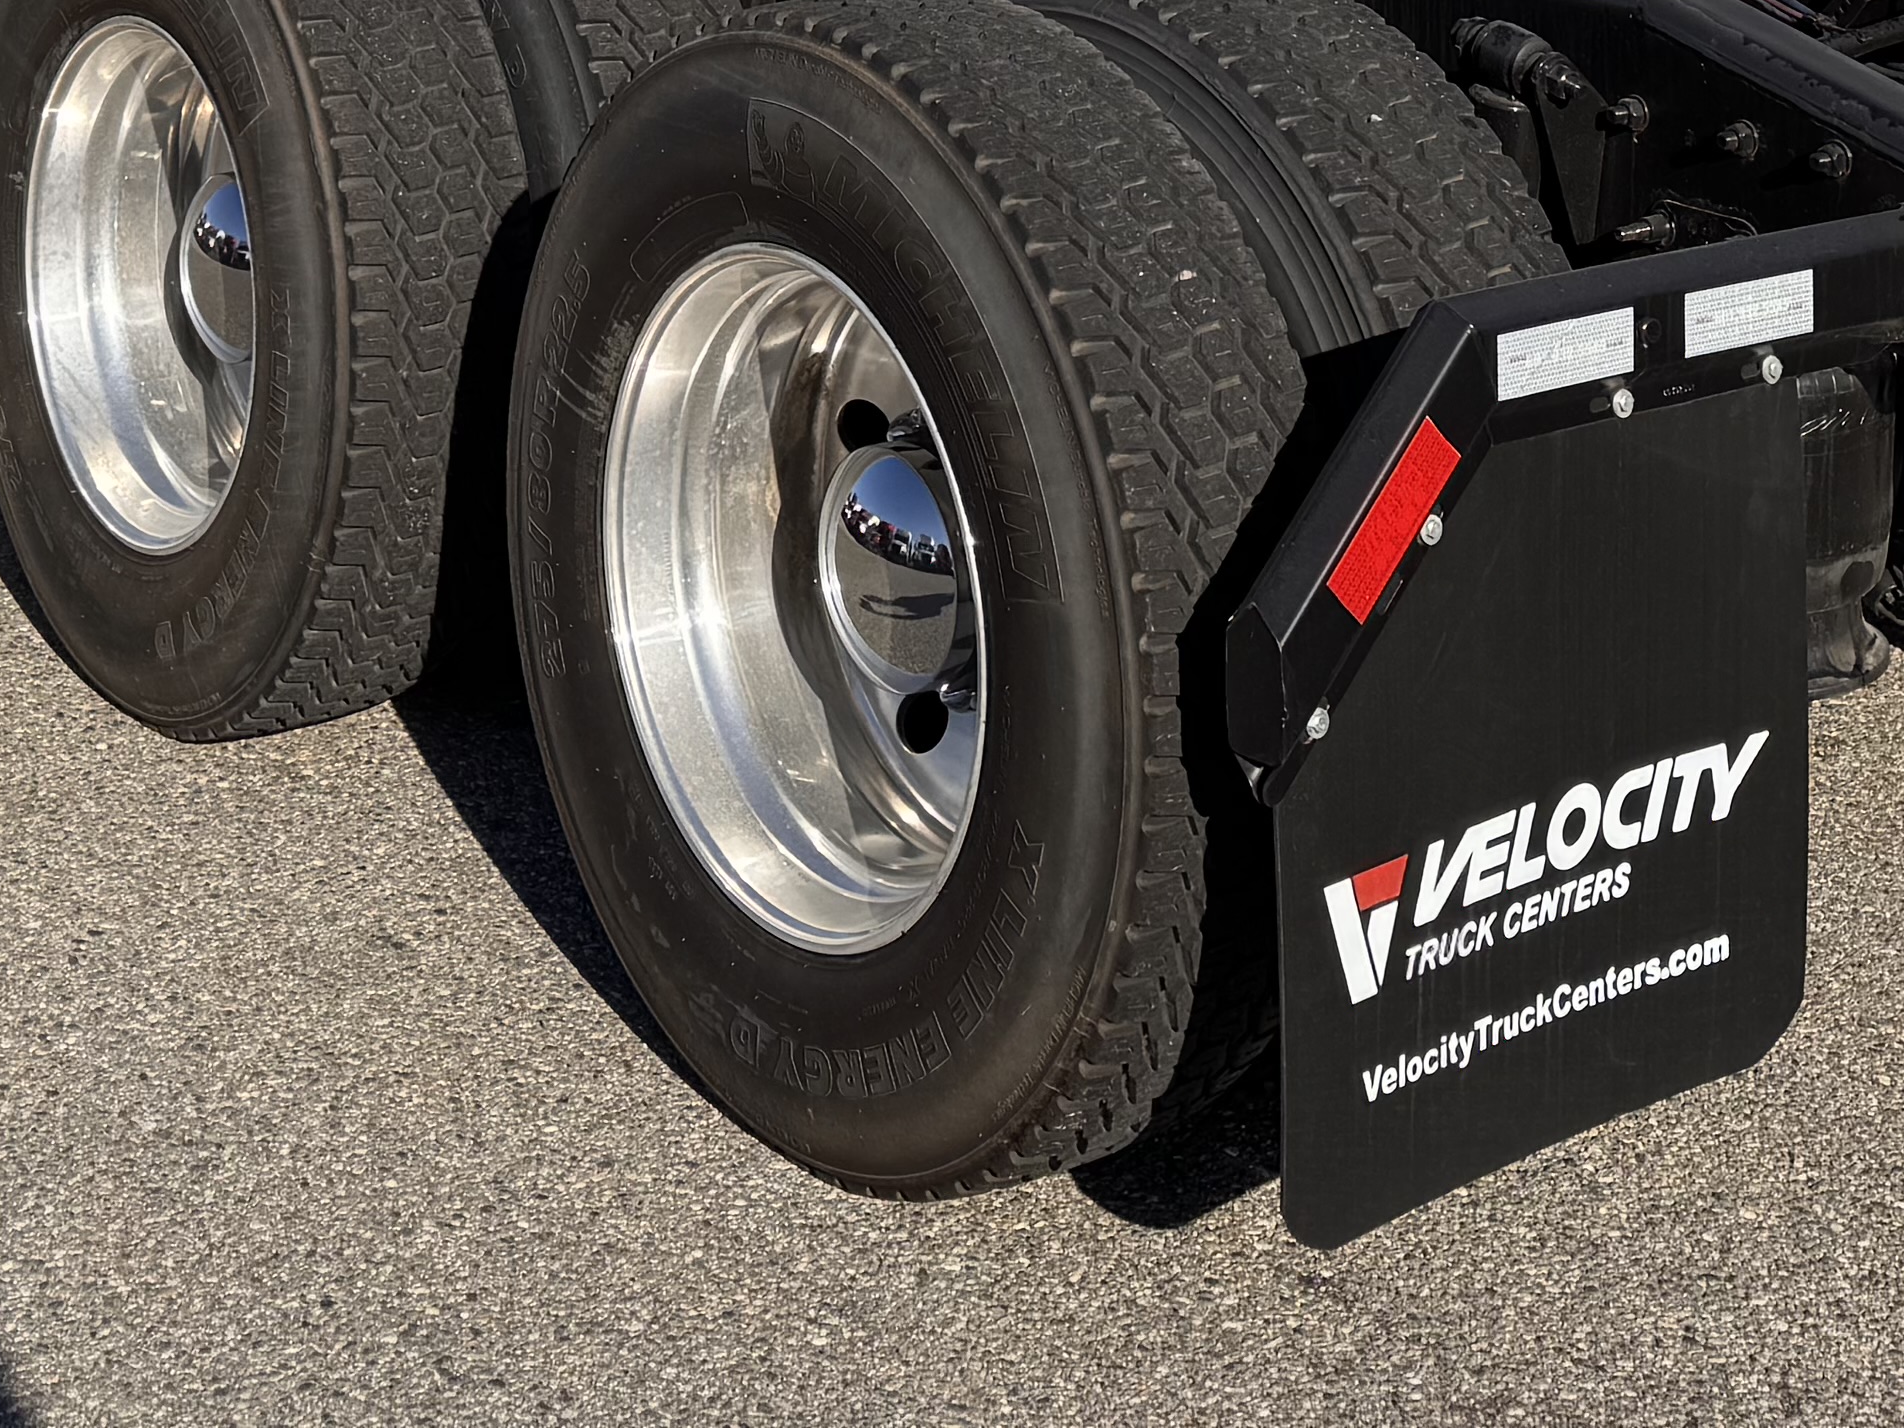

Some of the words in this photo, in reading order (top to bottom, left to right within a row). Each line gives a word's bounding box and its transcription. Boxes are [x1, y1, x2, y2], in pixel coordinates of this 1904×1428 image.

[823, 153, 1052, 596] MICHELIN
[527, 246, 591, 680] 275/80R22.5
[1413, 730, 1770, 928] VELOCITY
[946, 888, 1028, 1042] LINE
[1405, 907, 1495, 981] TRUCK
[1502, 861, 1632, 942] CENTERS
[728, 1016, 760, 1074] D
[769, 1009, 953, 1099] ENERGY
[1362, 932, 1731, 1103] VelocityTruckCenters.com
